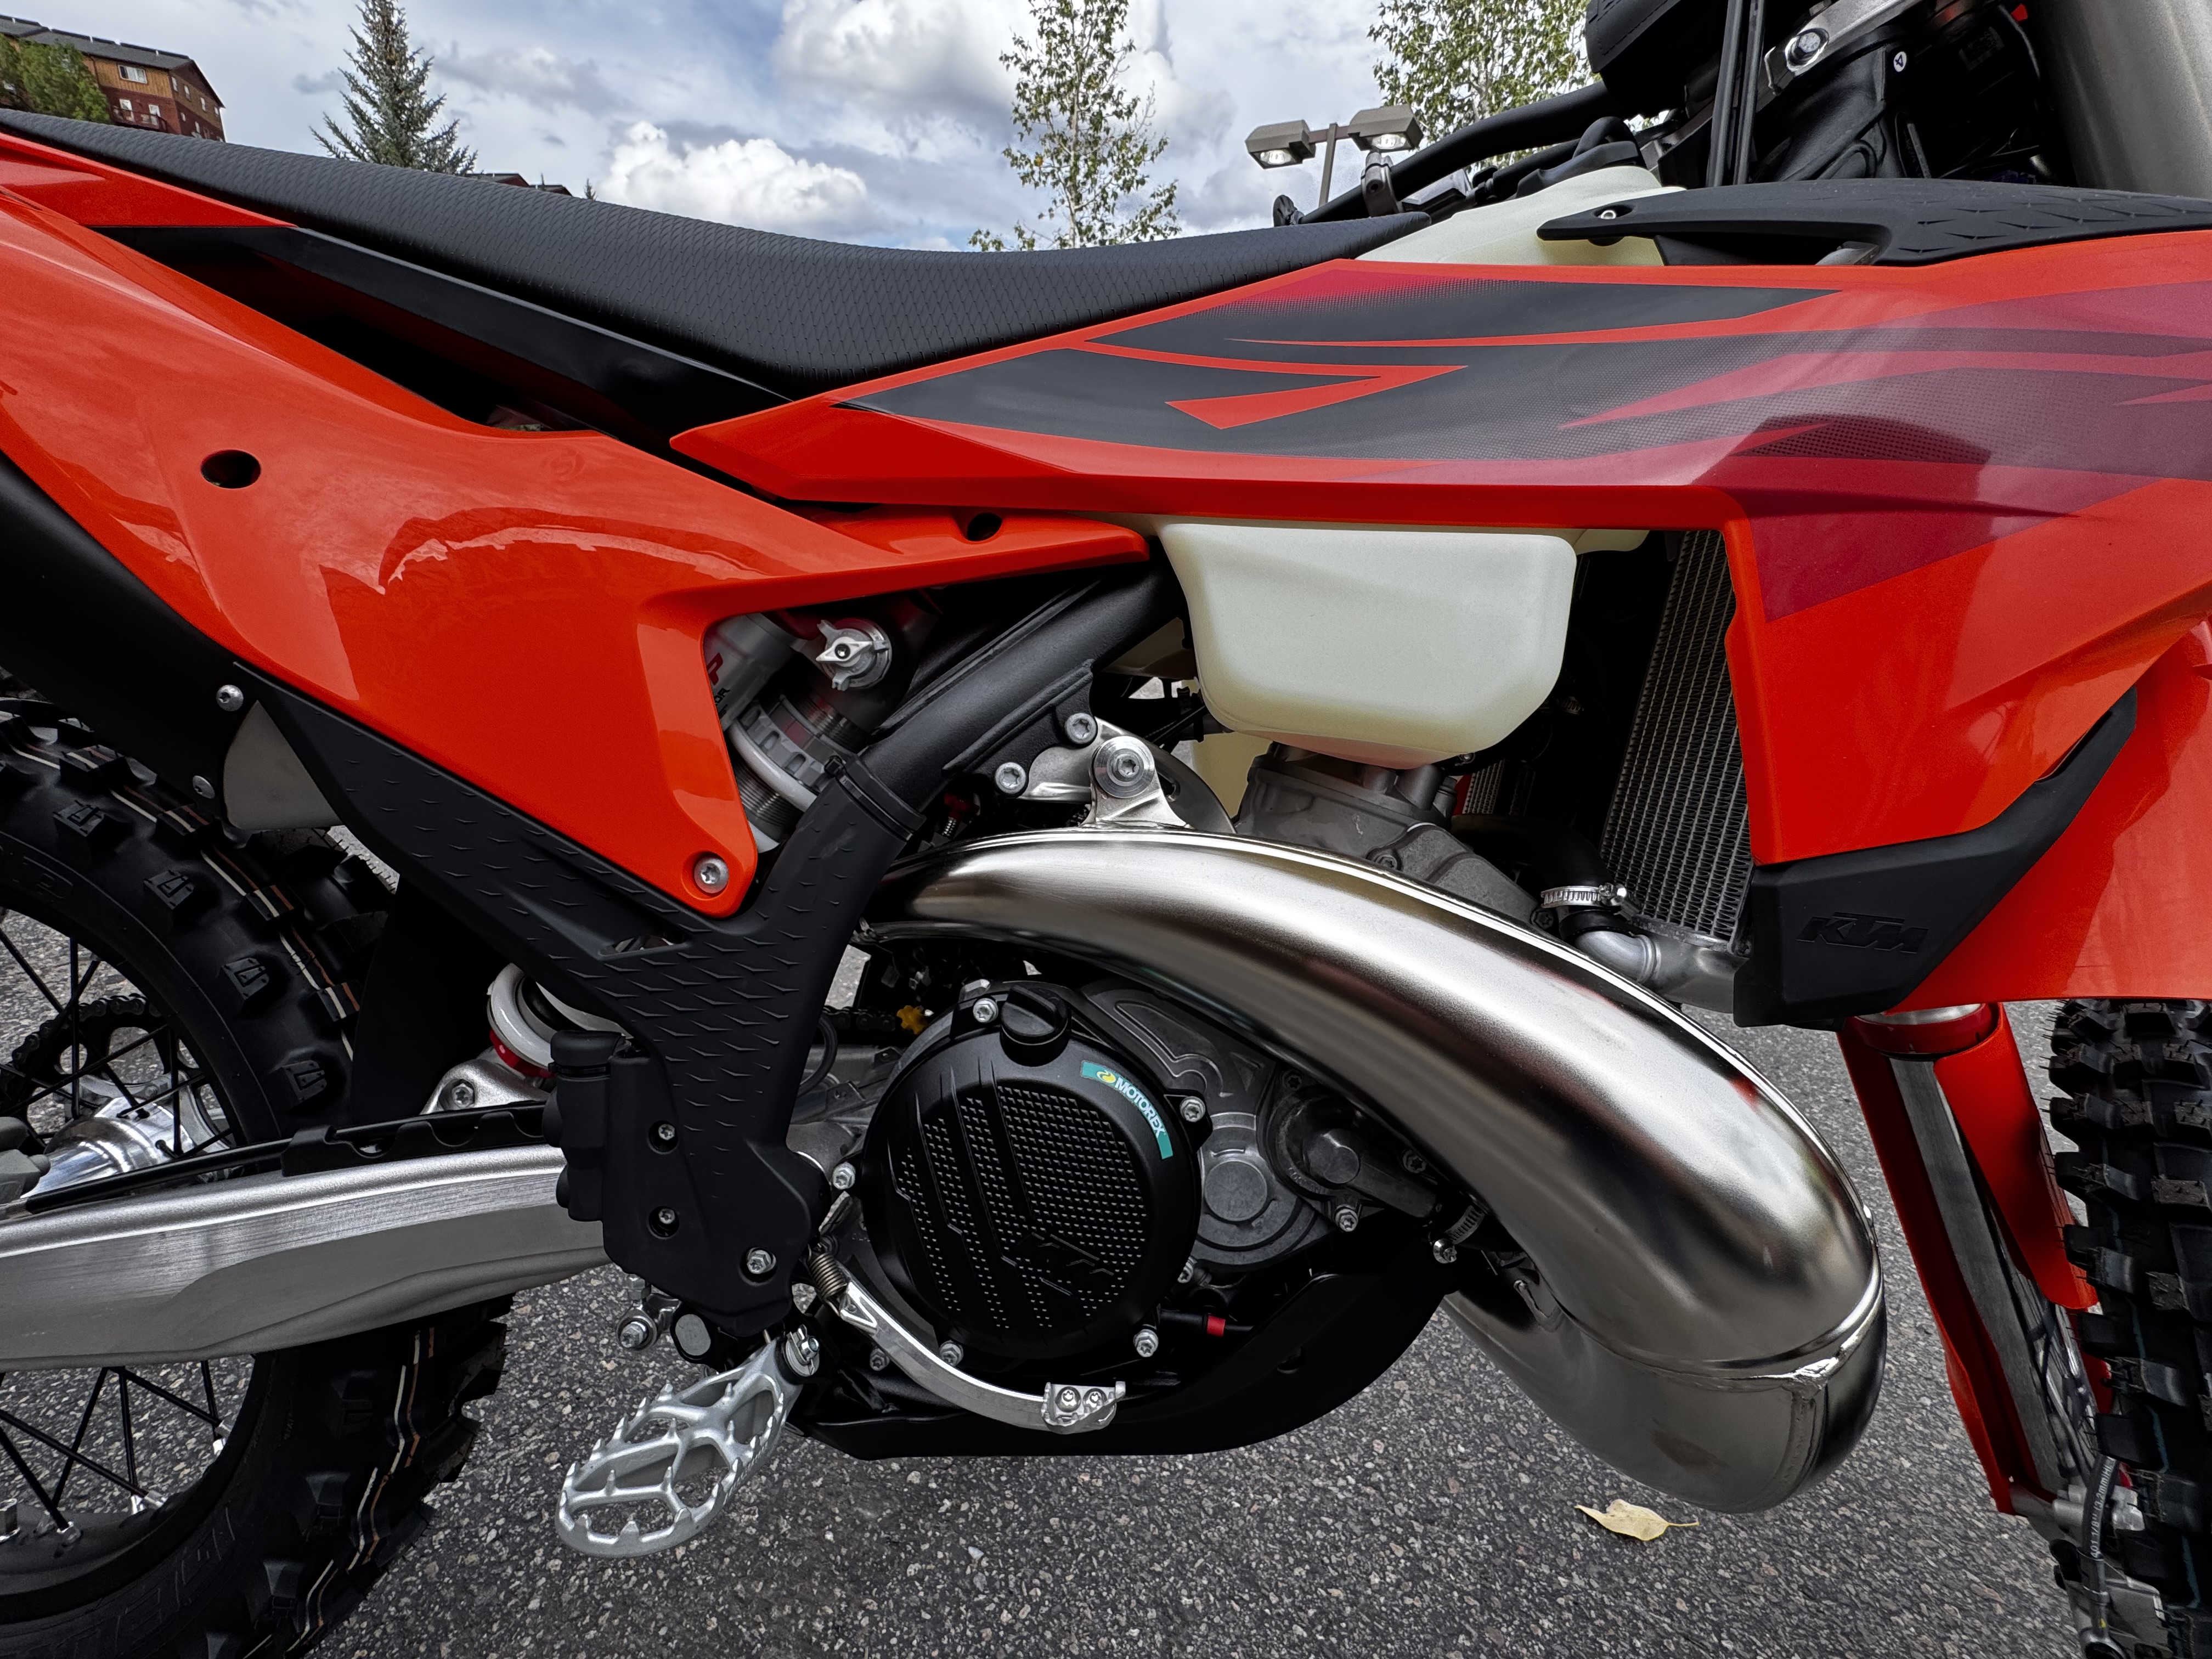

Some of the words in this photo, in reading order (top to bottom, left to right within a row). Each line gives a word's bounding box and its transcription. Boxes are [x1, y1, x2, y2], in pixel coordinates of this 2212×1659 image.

[706, 652, 723, 686] P
[714, 687, 730, 704] OR
[1795, 911, 1929, 953] KTM
[1114, 1077, 1165, 1138] MOTOREX
